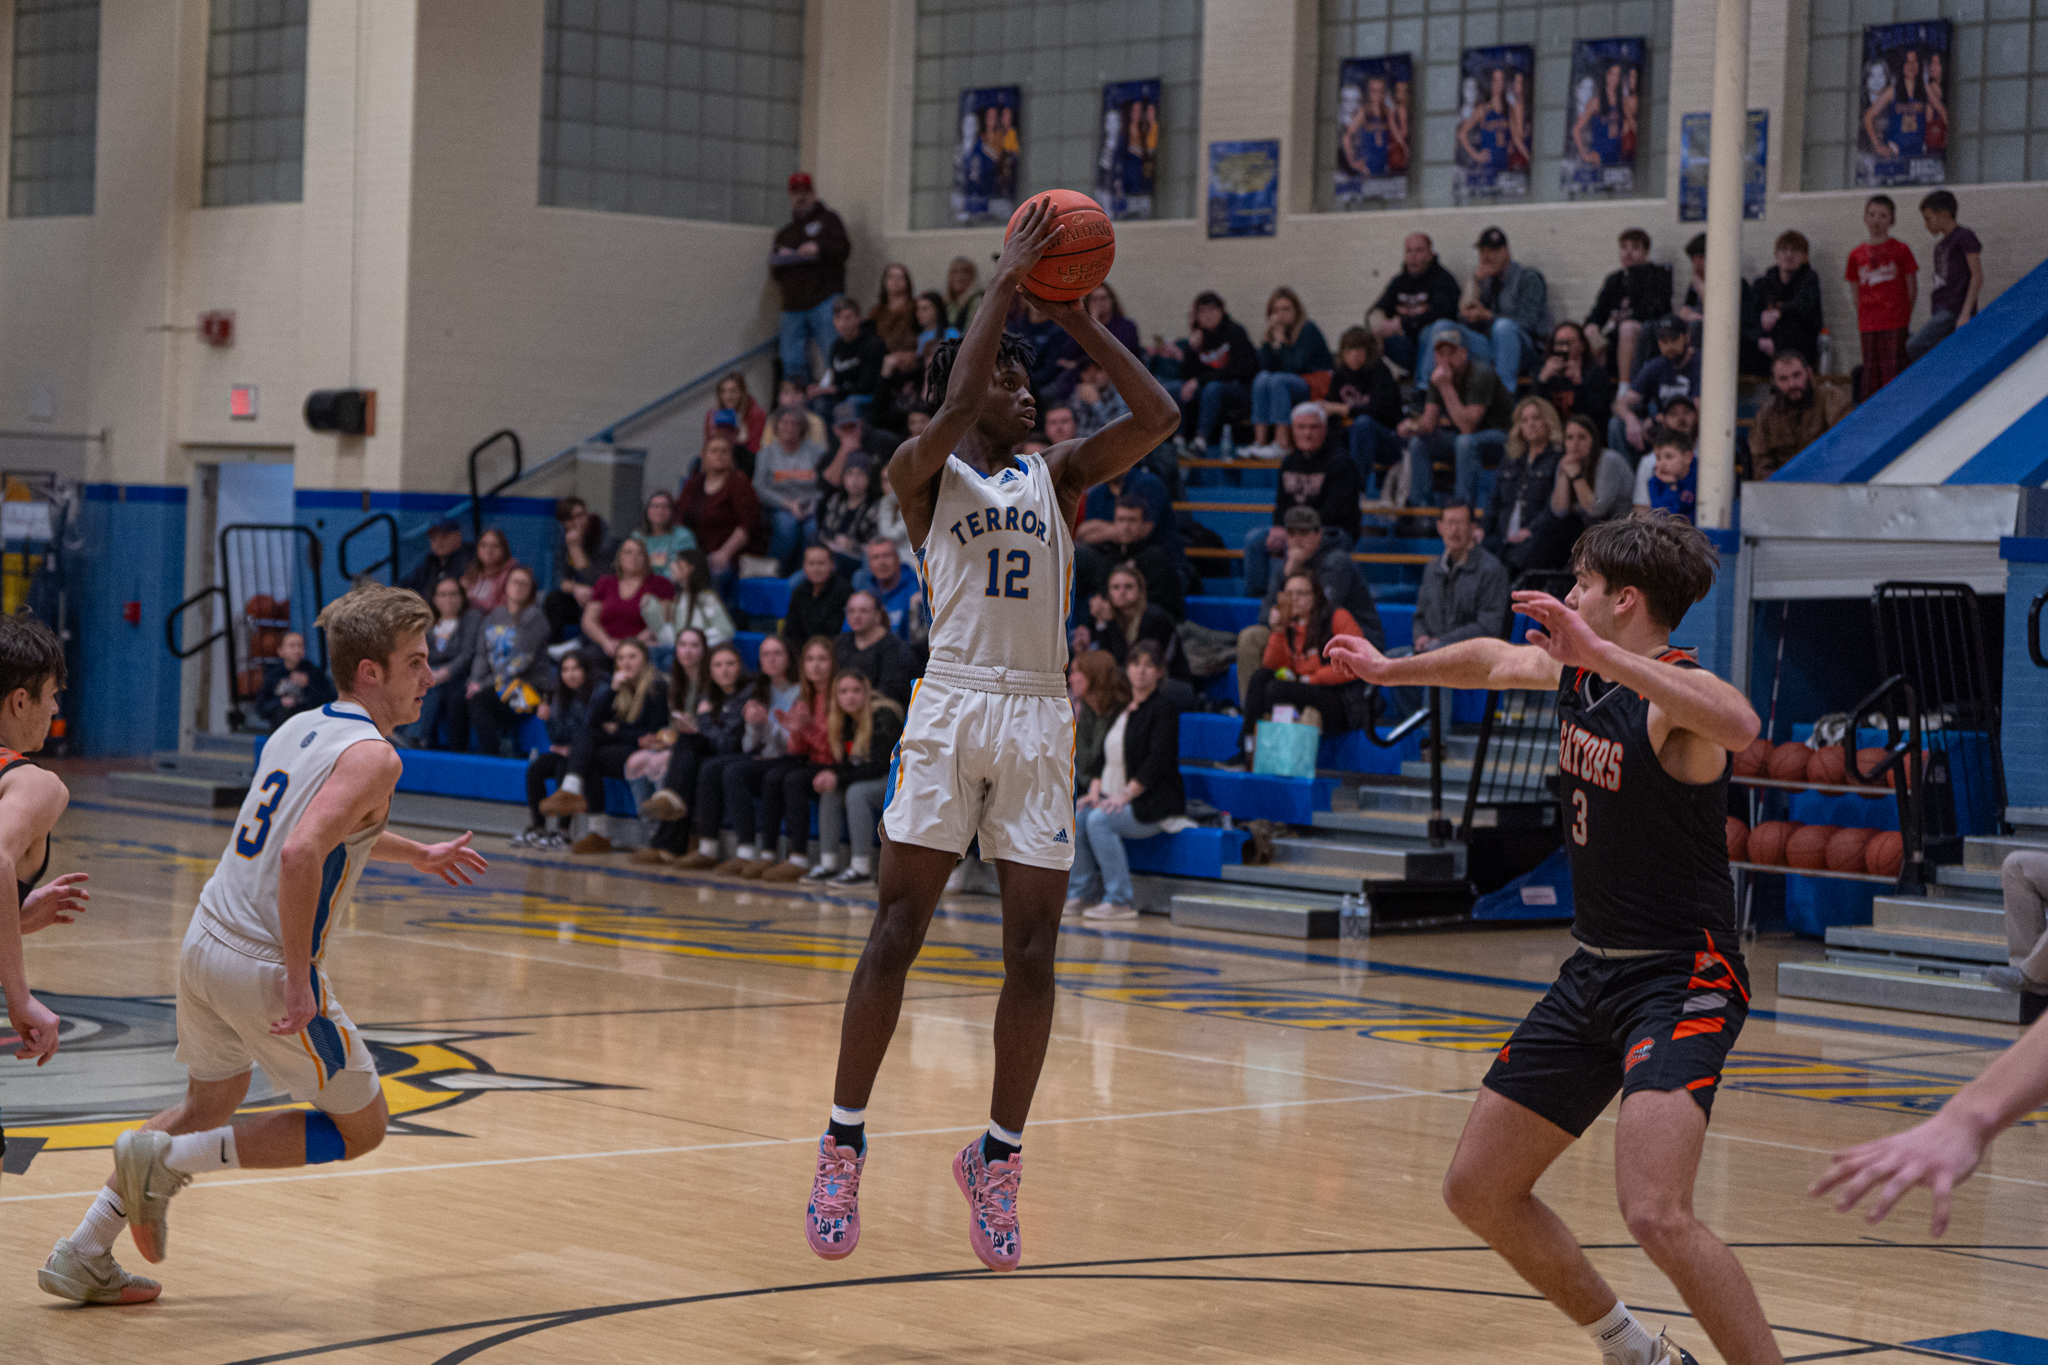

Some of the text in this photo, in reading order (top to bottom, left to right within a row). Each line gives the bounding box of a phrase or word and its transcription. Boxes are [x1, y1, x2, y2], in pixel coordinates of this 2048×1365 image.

[950, 506, 1052, 547] TERROR
[985, 548, 1031, 600] 12
[235, 768, 290, 861] 3
[1572, 788, 1588, 846] 3
